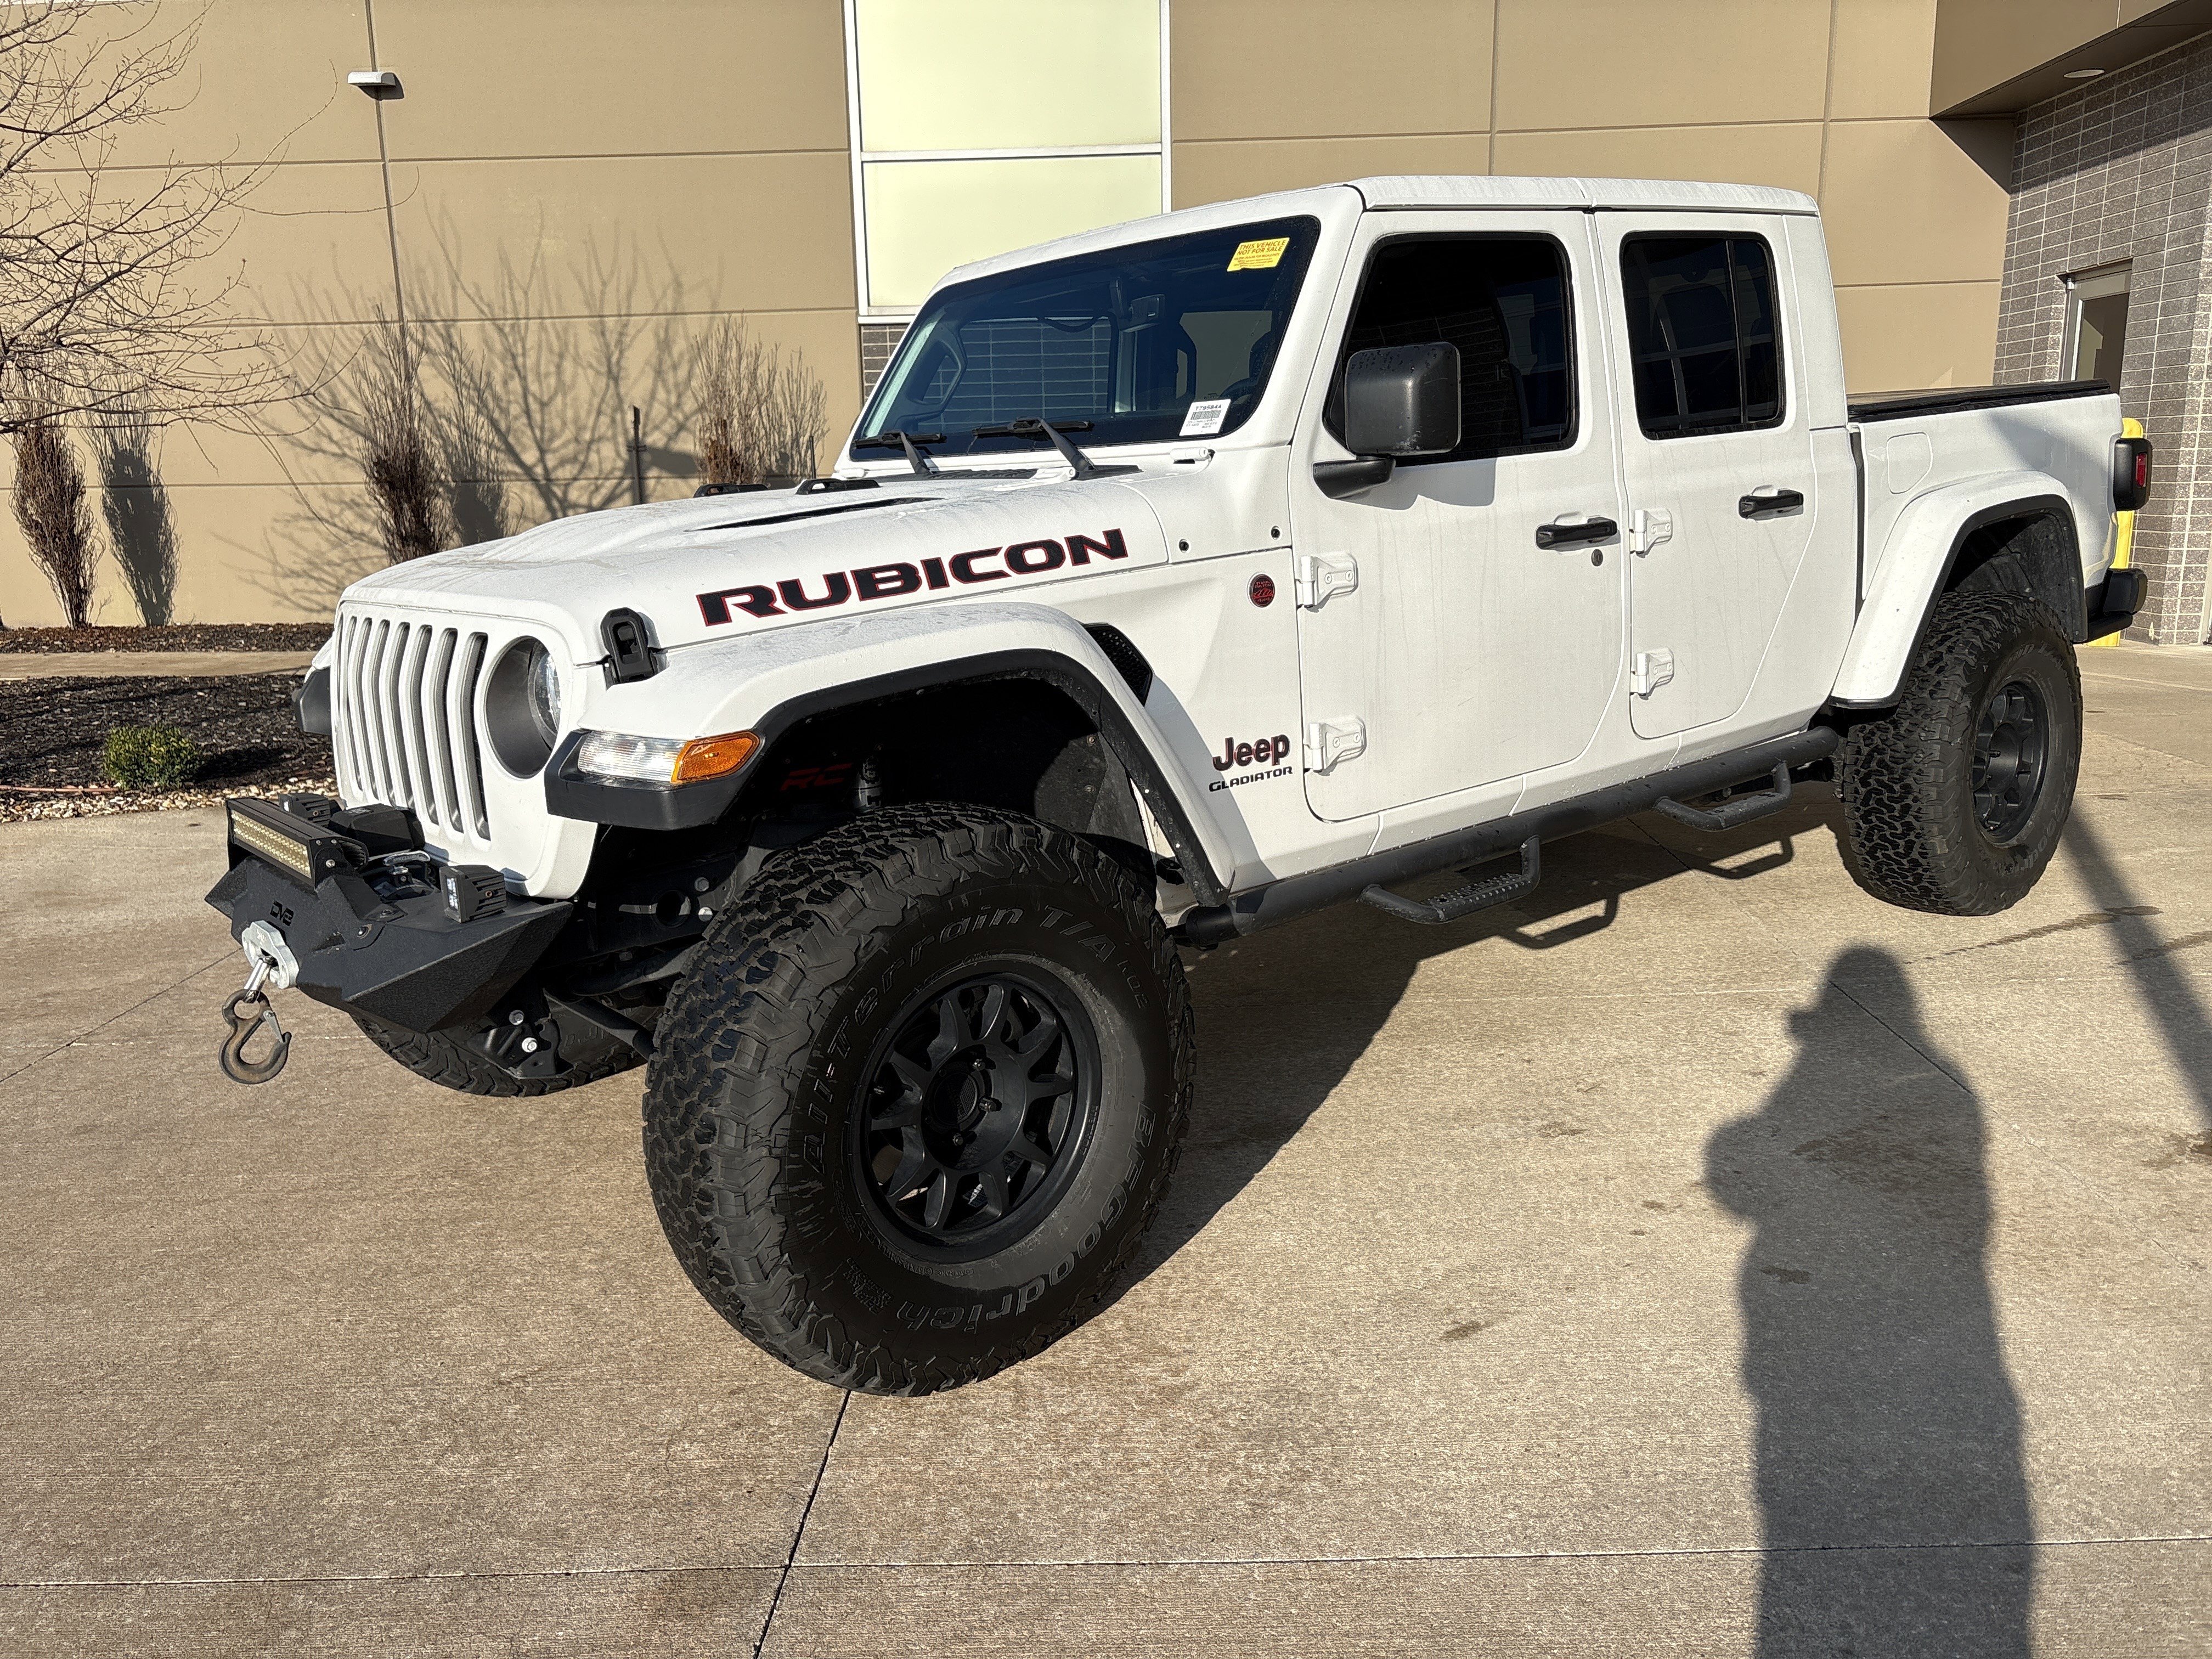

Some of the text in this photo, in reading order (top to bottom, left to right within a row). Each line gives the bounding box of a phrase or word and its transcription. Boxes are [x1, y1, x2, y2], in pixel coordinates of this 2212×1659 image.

[1256, 240, 1286, 249] VEHICLE
[696, 528, 1129, 627] RUBICON
[1212, 734, 1291, 771] Jeep
[1209, 766, 1294, 792] GLADIATOR
[1039, 904, 1118, 963] T/A
[896, 1101, 1156, 1334] BFGoodrich
